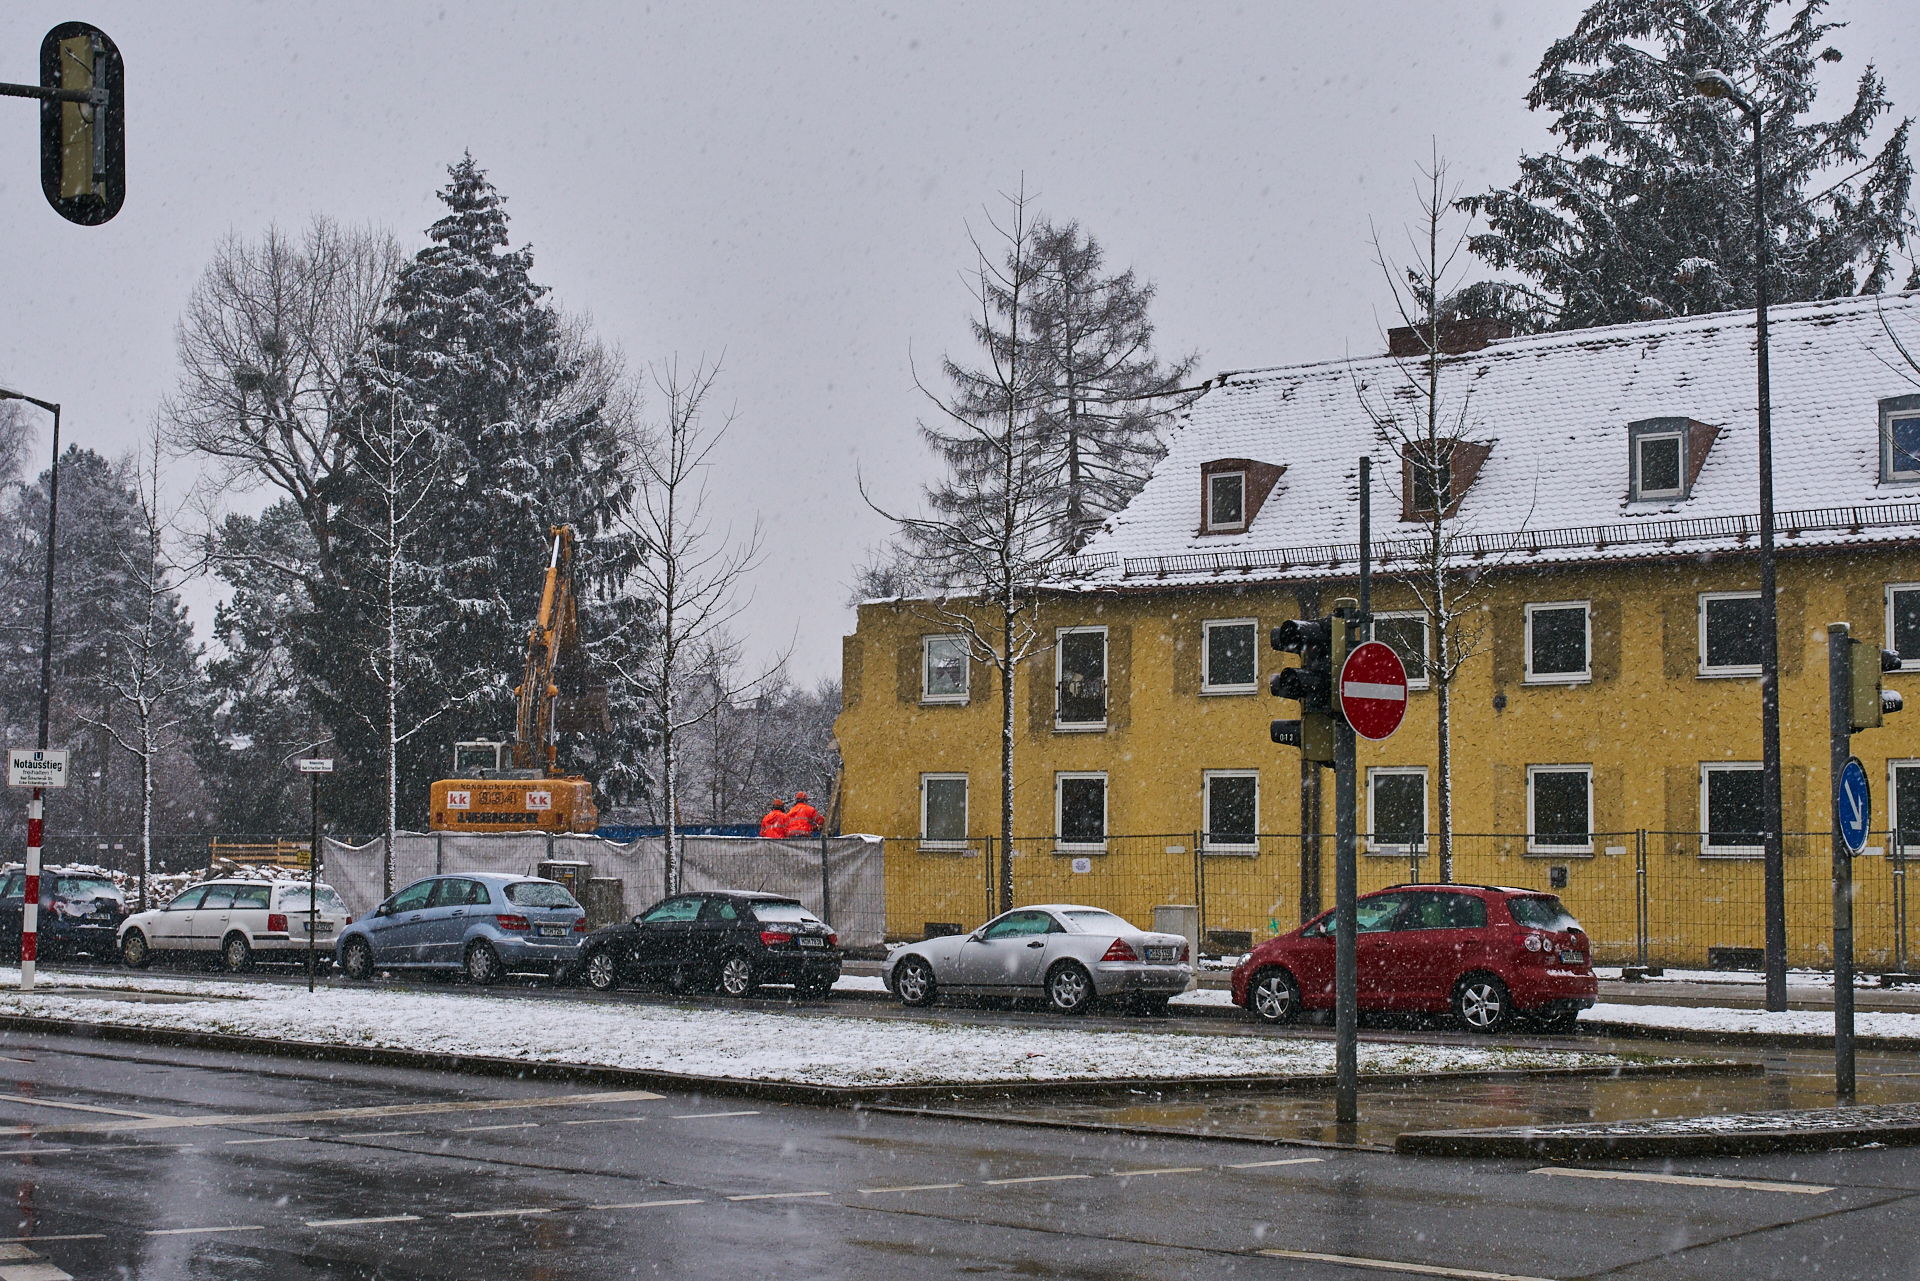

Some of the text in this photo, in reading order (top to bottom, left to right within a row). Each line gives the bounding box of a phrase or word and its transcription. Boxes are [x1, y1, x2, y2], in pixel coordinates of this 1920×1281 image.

[13, 759, 62, 772] Notausstieg
[479, 792, 516, 805] 934
[458, 812, 539, 824] LIEBHERR
